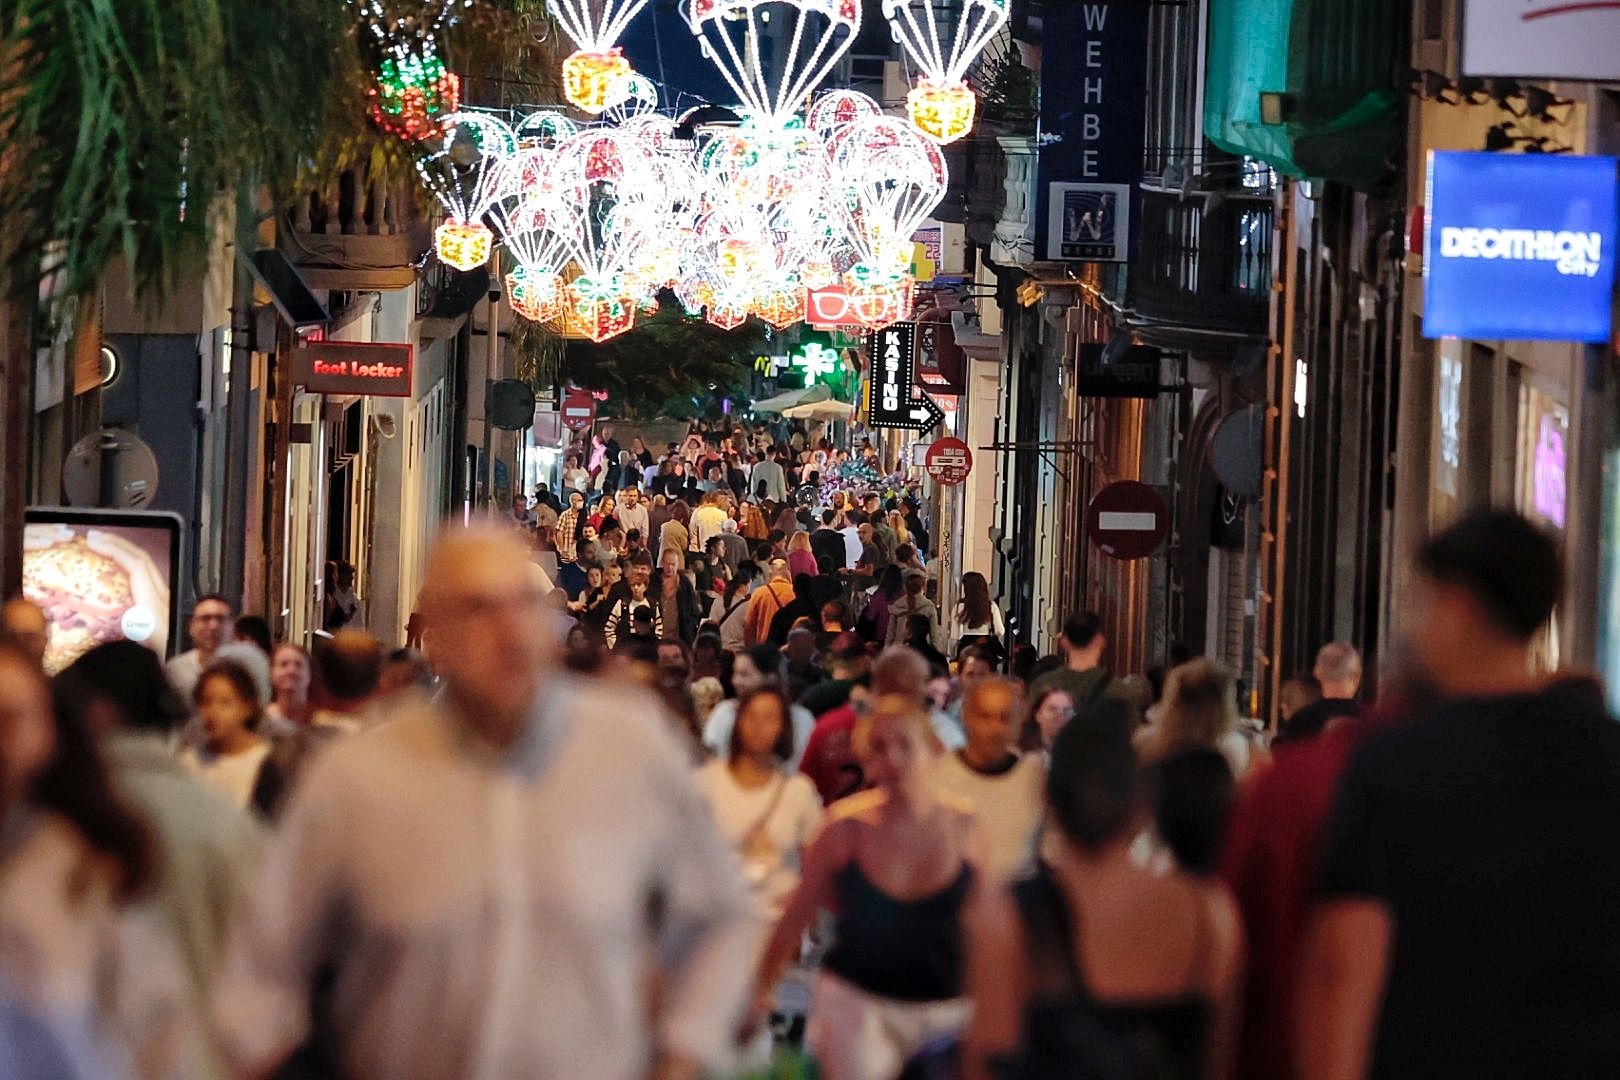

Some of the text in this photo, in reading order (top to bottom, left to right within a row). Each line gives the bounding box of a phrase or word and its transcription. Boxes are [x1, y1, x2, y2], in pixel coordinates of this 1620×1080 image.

[1082, 4, 1108, 177] WEHBE
[314, 360, 403, 377] Foot Locker
[883, 331, 900, 411] KASINO
